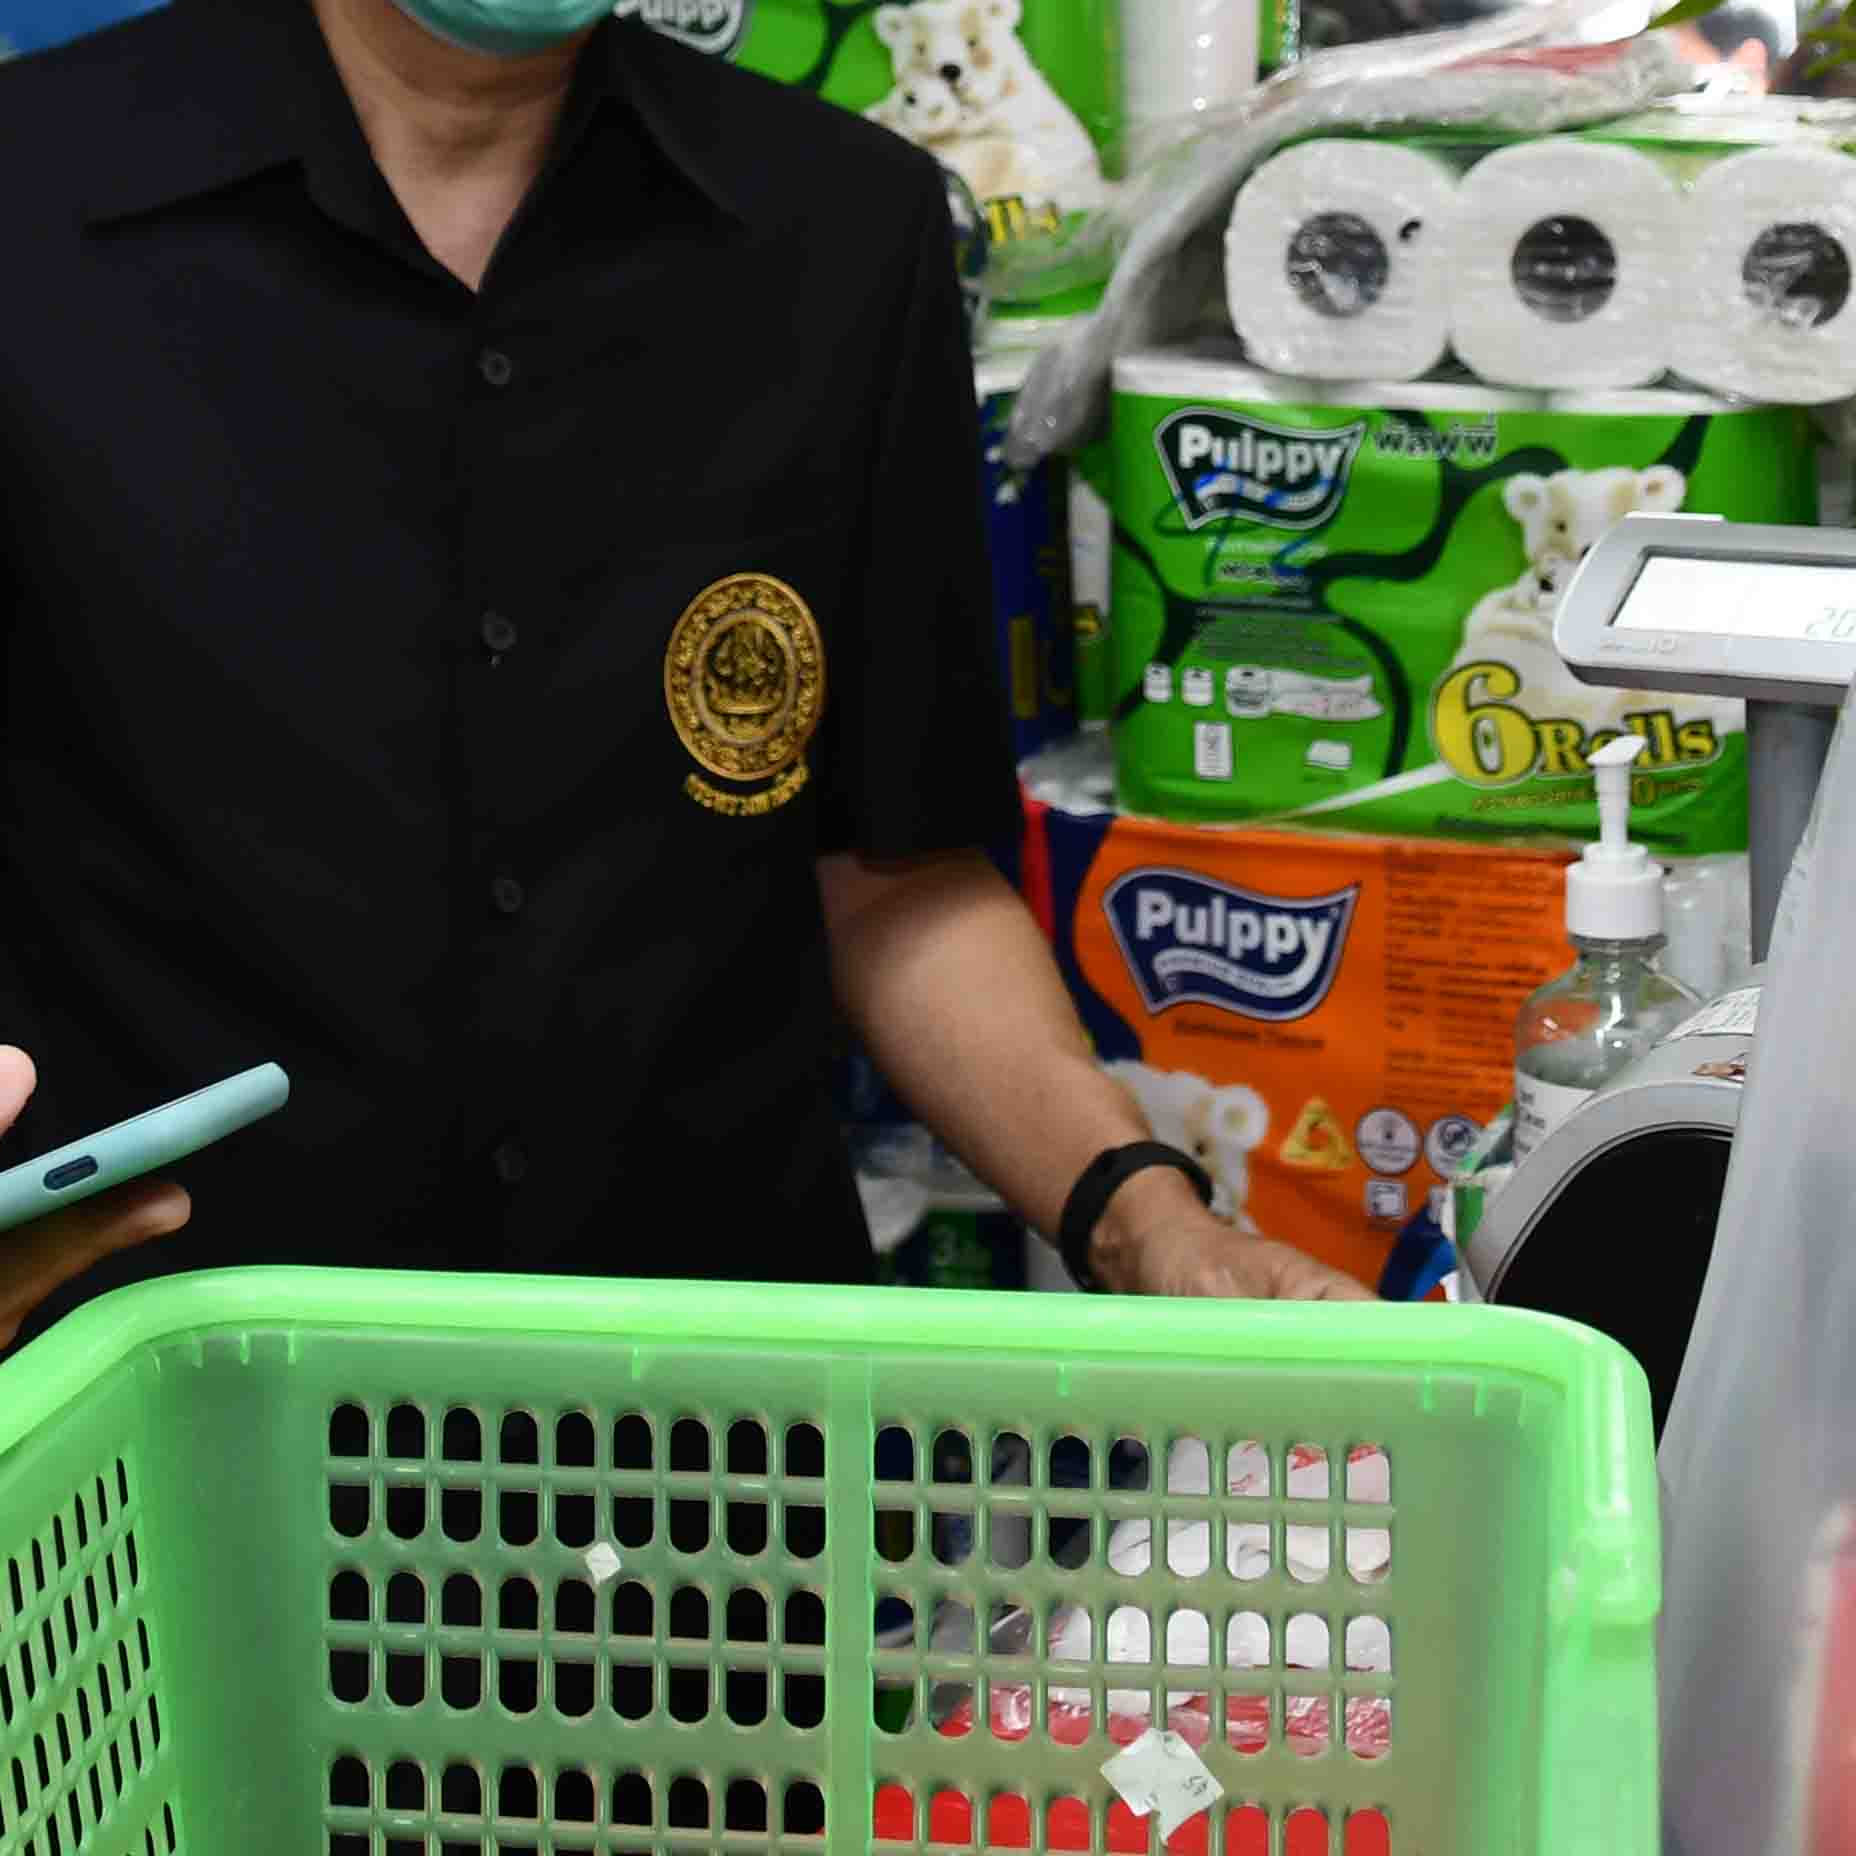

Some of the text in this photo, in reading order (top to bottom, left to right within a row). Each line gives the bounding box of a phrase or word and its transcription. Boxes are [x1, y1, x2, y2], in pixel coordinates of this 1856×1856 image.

[1178, 423, 1342, 484] Pulppy
[1434, 661, 1538, 784] 6
[1137, 888, 1332, 968] Pulppy
